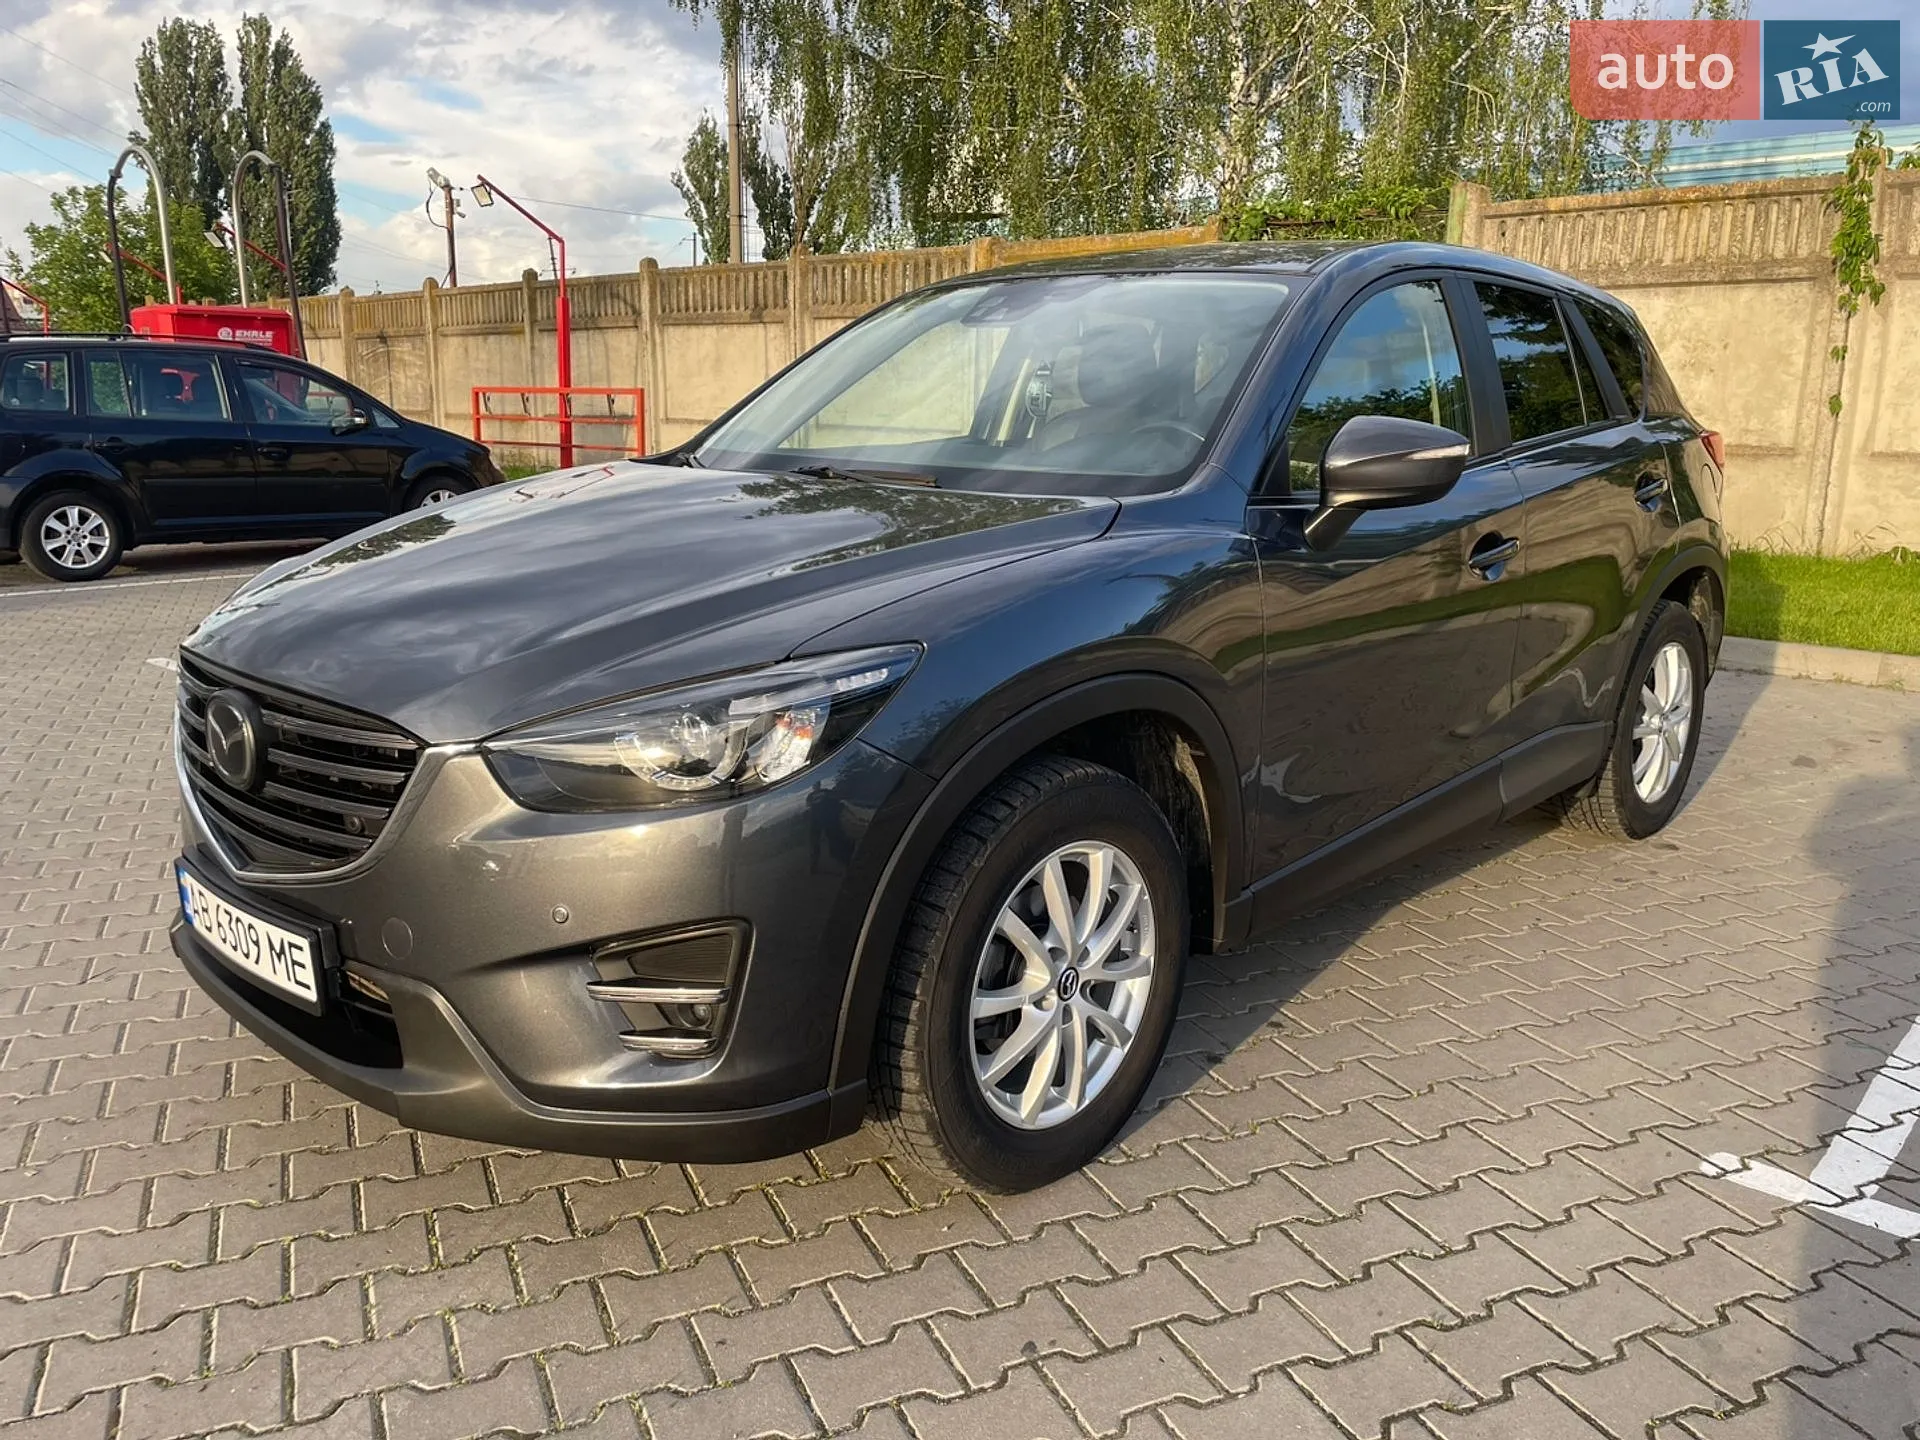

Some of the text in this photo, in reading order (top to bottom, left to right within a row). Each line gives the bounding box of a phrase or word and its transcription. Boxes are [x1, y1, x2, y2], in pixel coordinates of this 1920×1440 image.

[235, 330, 273, 338] EHRLE
[190, 882, 311, 991] AB 6309 ME
